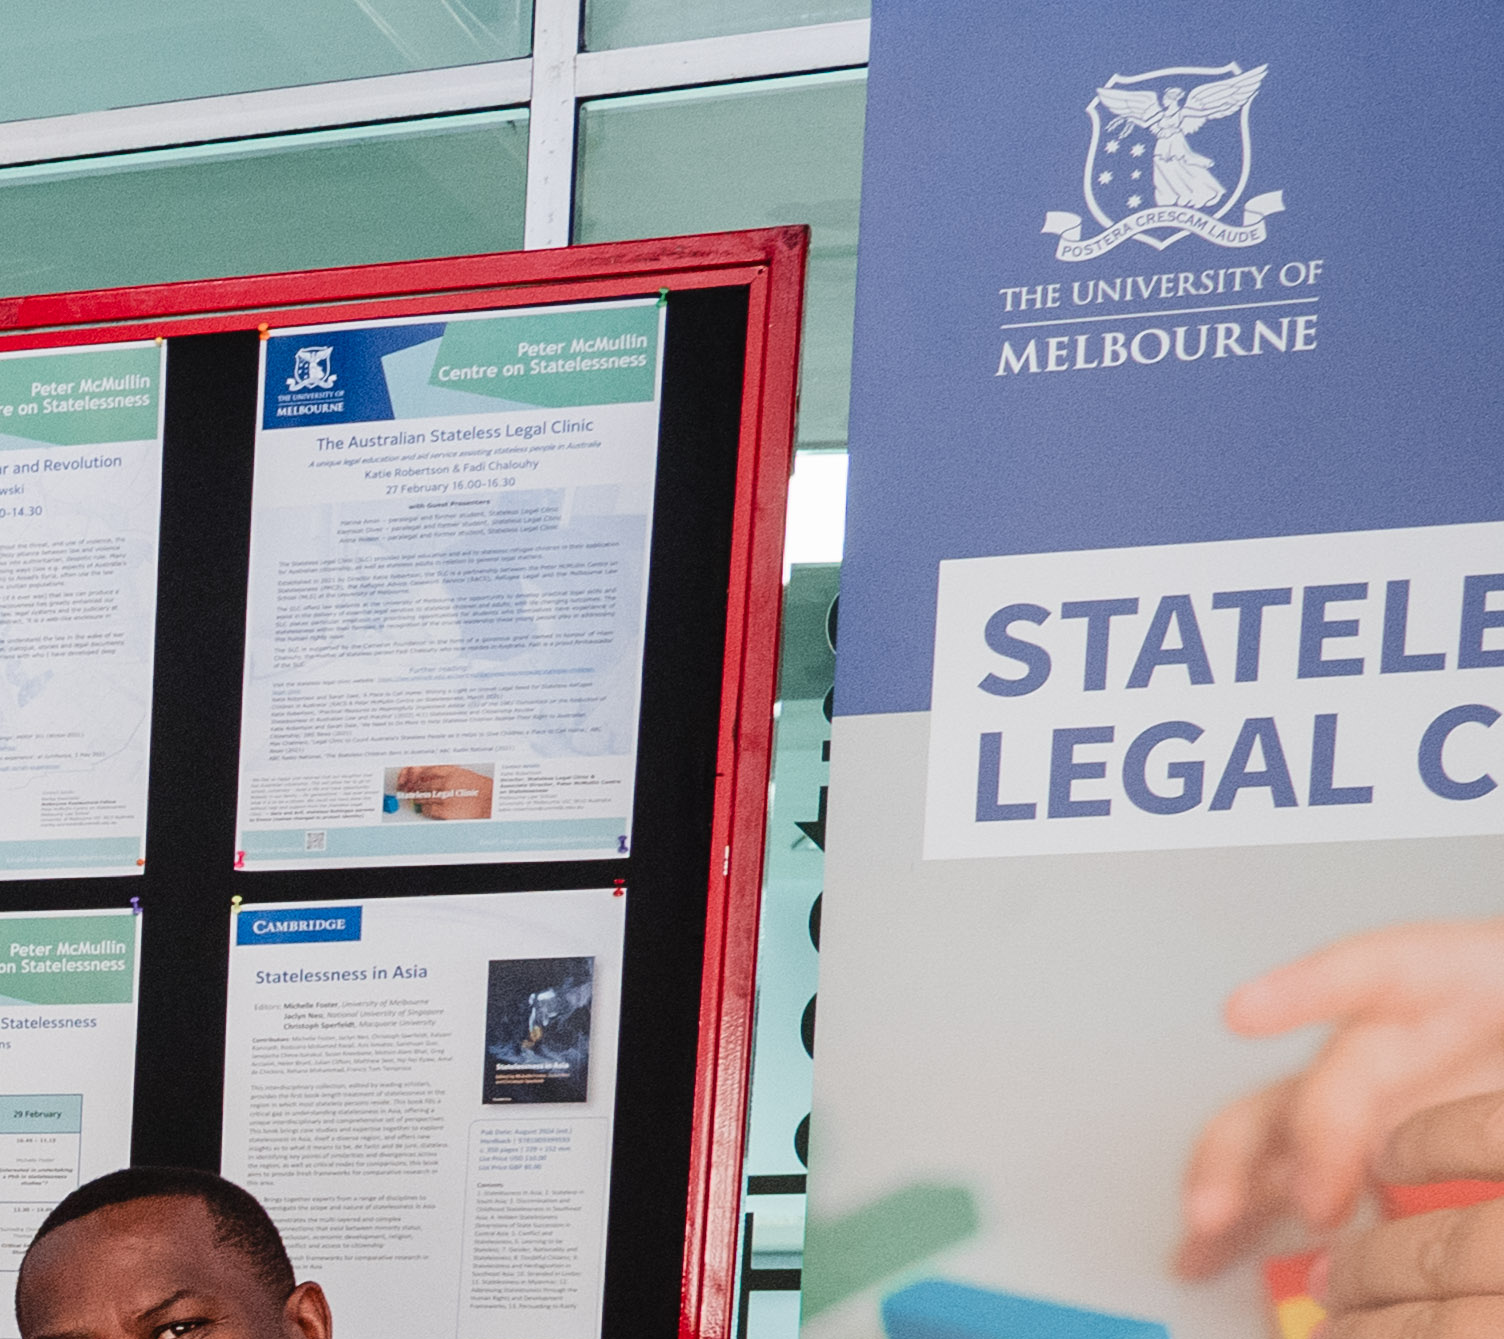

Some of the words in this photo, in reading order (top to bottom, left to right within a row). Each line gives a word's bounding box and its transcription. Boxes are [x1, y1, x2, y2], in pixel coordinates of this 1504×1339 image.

[1061, 224, 1132, 259] POSTERA
[1138, 211, 1208, 231] CRESCAM
[1208, 225, 1260, 242] LAUDE
[999, 284, 1061, 312] THE
[1073, 265, 1271, 306] UNIVERSITY
[1279, 260, 1323, 287] OF
[518, 341, 566, 358] Peter
[570, 334, 647, 354] McMullin
[995, 315, 1318, 377] MELBOURNE
[438, 365, 498, 382] Centre
[503, 363, 525, 376] on
[530, 353, 647, 375] Statelessness
[31, 381, 75, 398] Peter
[79, 374, 150, 394] McMullin
[18, 402, 39, 416] on
[42, 393, 150, 415] Statelessness
[277, 401, 344, 417] MELBOURNE
[316, 437, 345, 452] The
[348, 431, 426, 450] Australian
[429, 426, 501, 444] Stateless
[505, 423, 547, 440] Legal
[551, 418, 594, 434] Clinic
[13, 460, 39, 474] and
[44, 455, 122, 472] Revolution
[364, 467, 392, 480] Katie
[394, 464, 449, 479] Robertson
[453, 462, 461, 473] &
[463, 460, 486, 473] Fadi
[488, 458, 539, 473] Chalouhy
[386, 484, 399, 495] 27
[401, 480, 449, 496] February
[975, 713, 1373, 823] LEGAL
[253, 919, 346, 935] CAMBRIDGE
[10, 944, 54, 957] Peter
[57, 941, 125, 955] McMullin
[21, 958, 125, 973] Statelessness
[256, 969, 367, 984] Statelessness
[373, 966, 387, 979] in
[392, 965, 428, 979] Asia
[0, 1016, 97, 1030] Statelessness
[13, 1110, 23, 1118] 29
[25, 1109, 62, 1120] February
